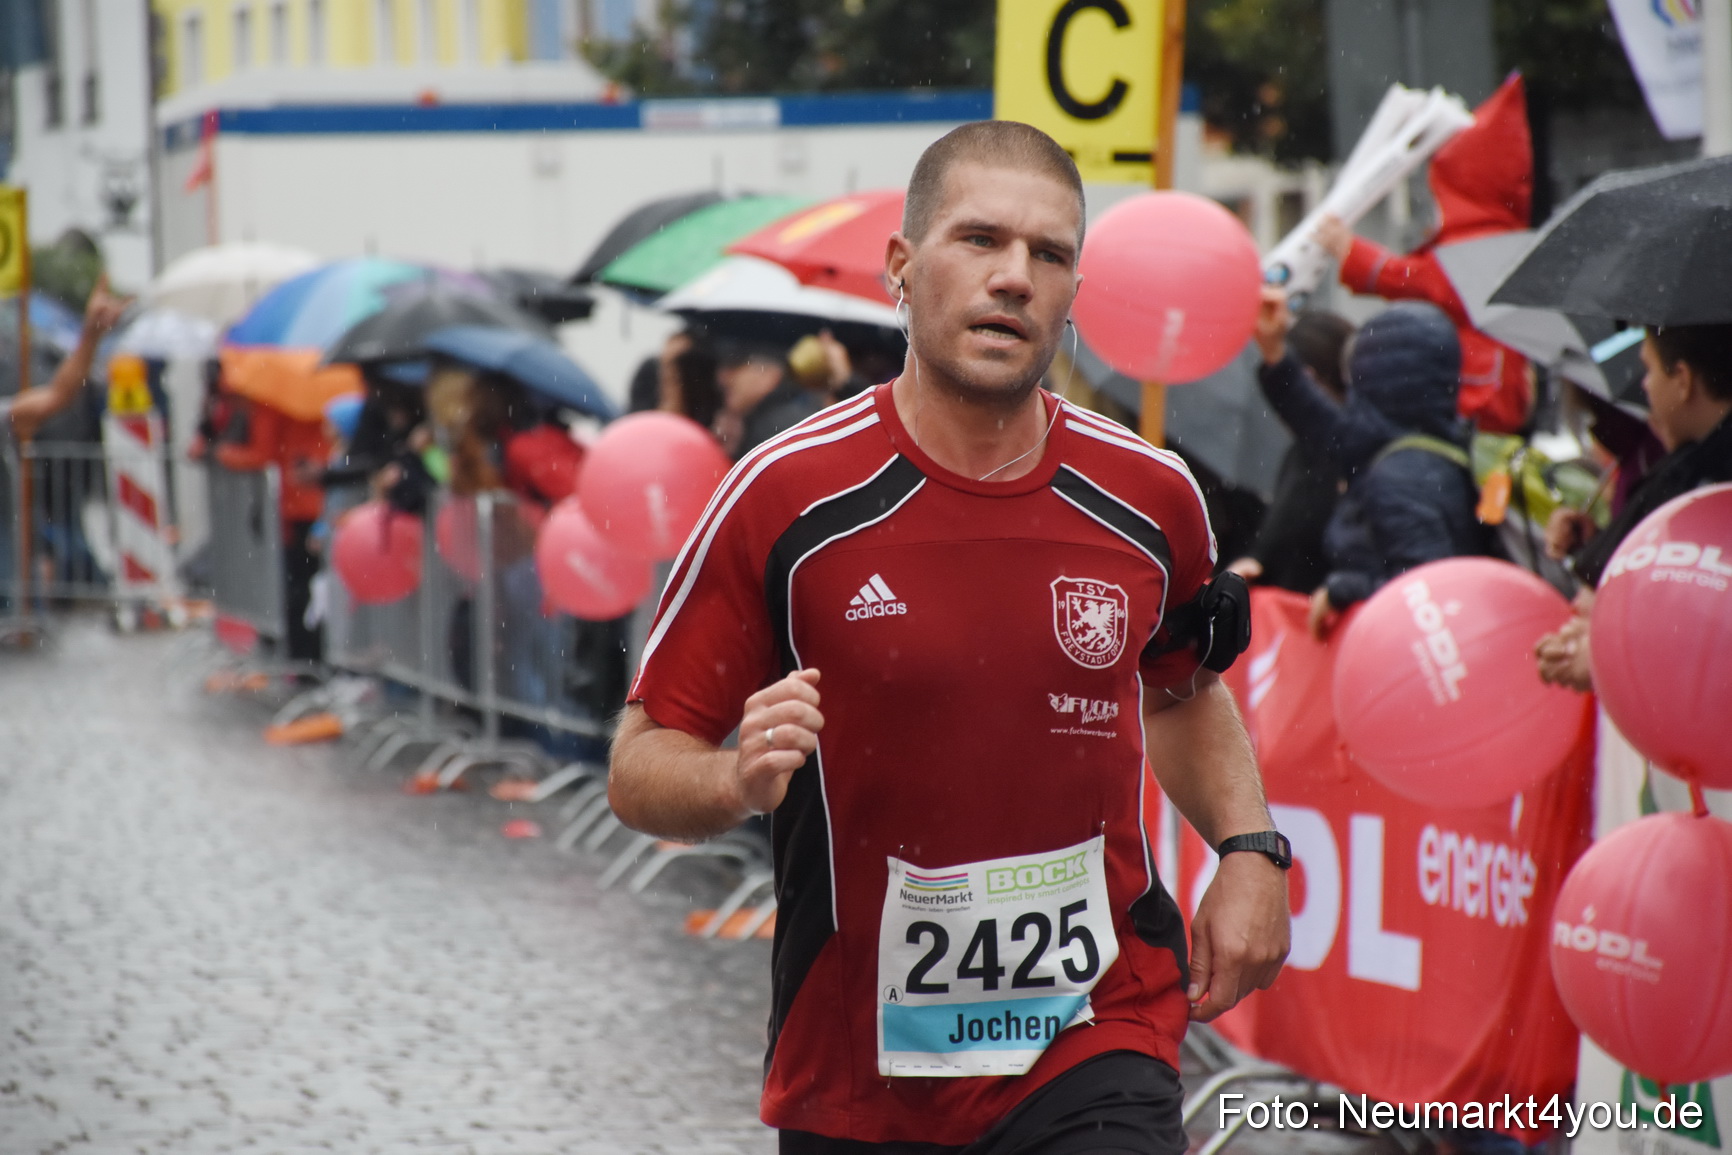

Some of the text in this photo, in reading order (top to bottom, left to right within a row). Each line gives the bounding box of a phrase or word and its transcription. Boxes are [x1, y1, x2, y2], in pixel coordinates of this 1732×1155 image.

[1046, 0, 1131, 120] C
[1076, 582, 1107, 597] TSV
[845, 600, 907, 621] adidas
[1058, 600, 1066, 610] 19
[986, 850, 1088, 895] BOCK
[900, 888, 973, 905] NeuerMarkt
[987, 891, 1022, 904] inspired
[1025, 891, 1035, 900] by
[1038, 887, 1060, 898] smart
[905, 898, 1100, 995] 2425
[948, 1010, 1061, 1044] Jochen
